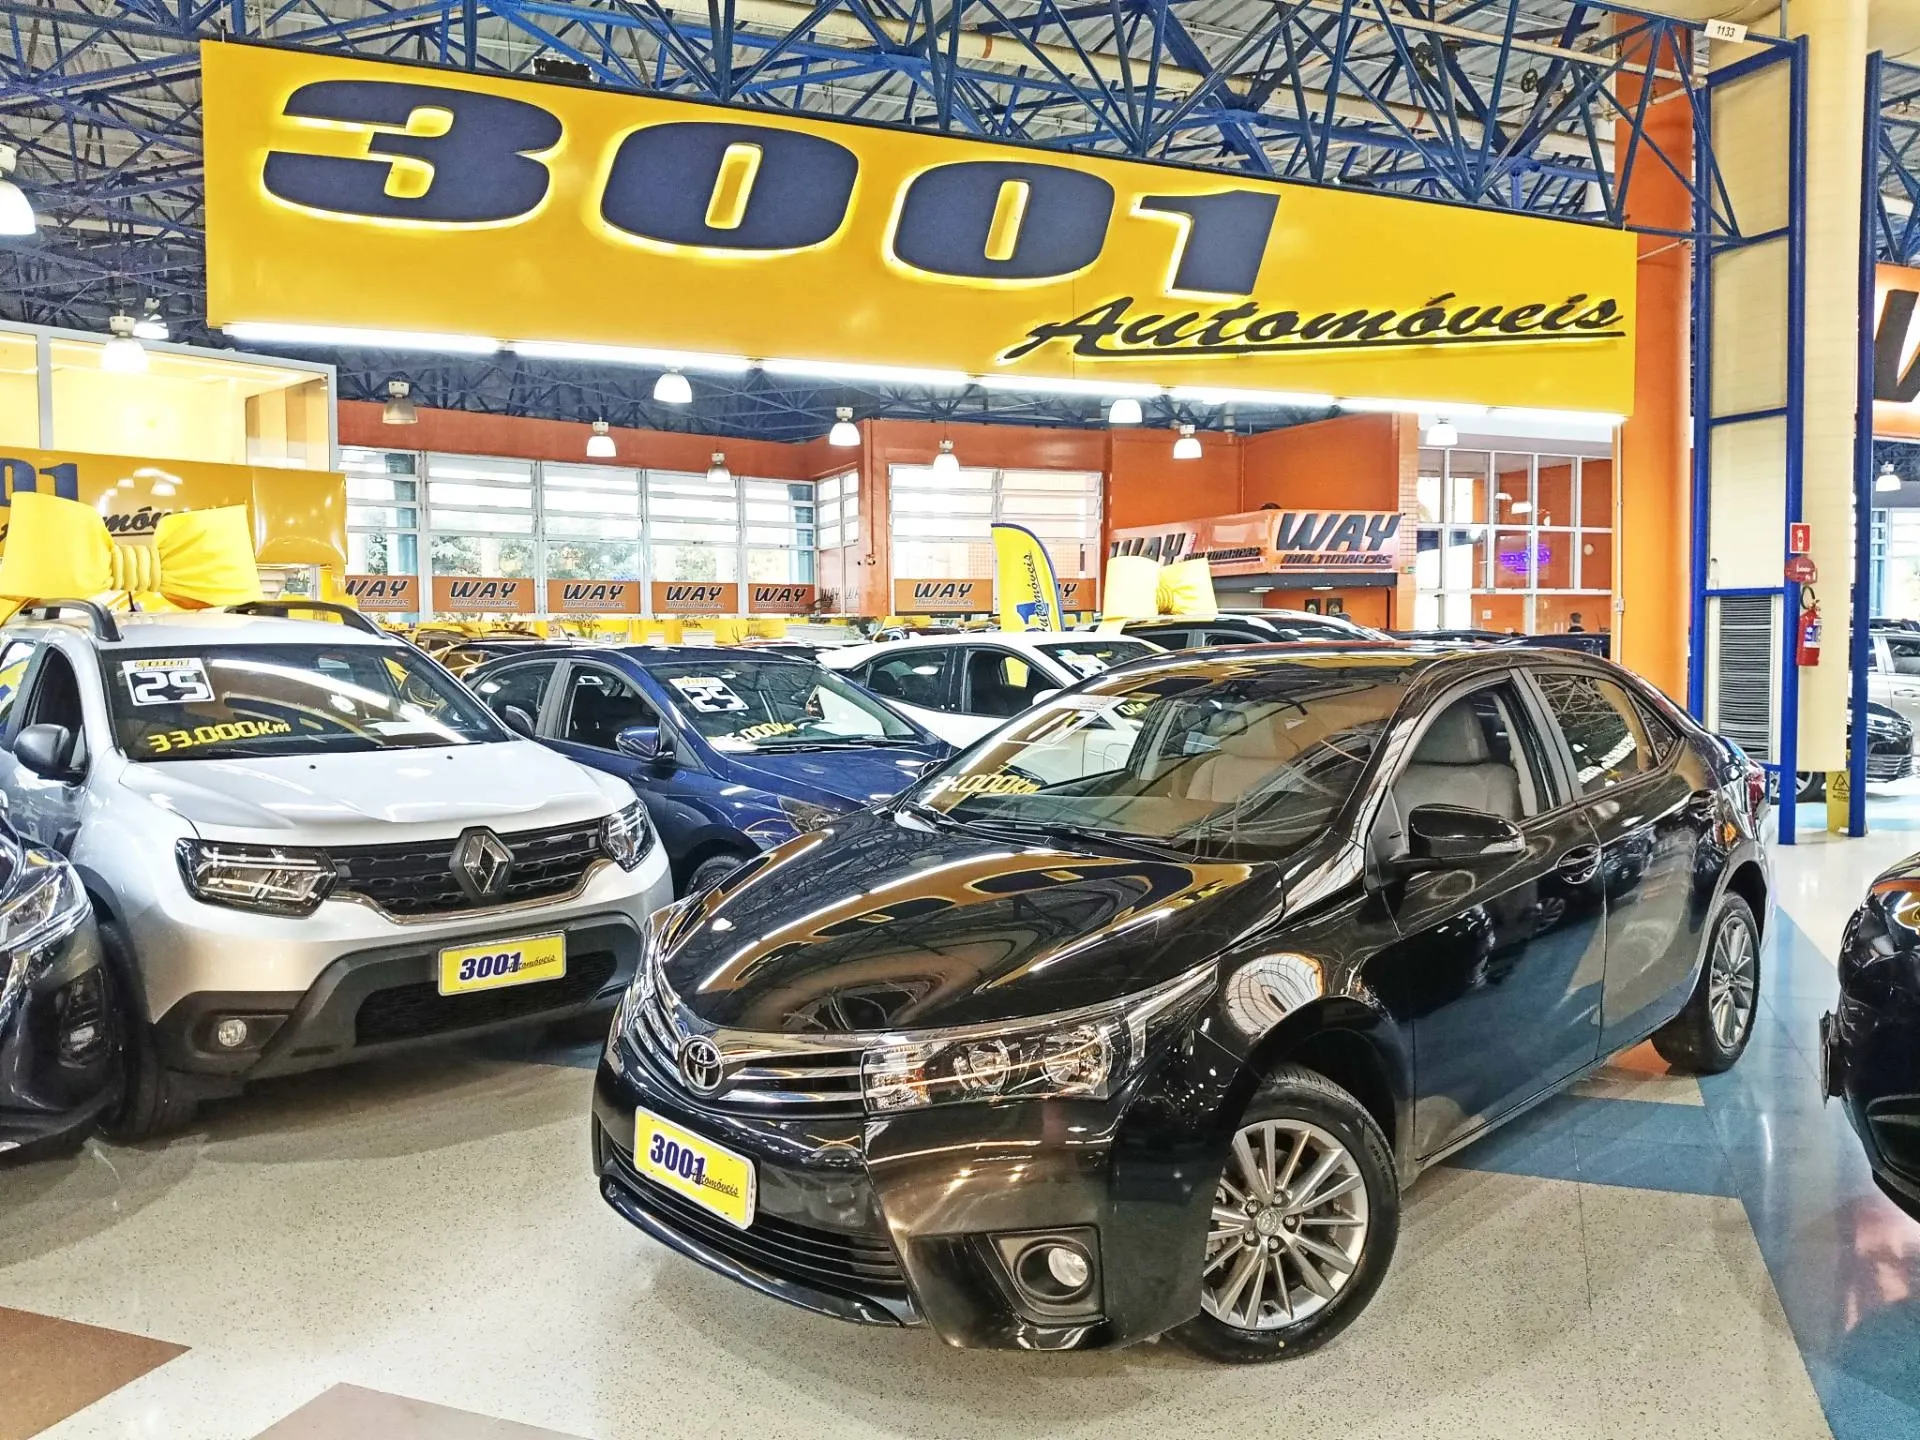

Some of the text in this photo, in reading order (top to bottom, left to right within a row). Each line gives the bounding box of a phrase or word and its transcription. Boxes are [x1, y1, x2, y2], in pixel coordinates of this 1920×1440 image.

[1717, 25, 1736, 37] 1133
[263, 79, 1280, 296] 3001
[1003, 292, 1627, 359] Automóveis
[1276, 513, 1401, 551] WAY
[1281, 553, 1393, 565] MULTIMARCAS
[450, 582, 517, 598] WAY
[563, 584, 624, 600] WAY
[666, 586, 722, 601] WAY
[755, 587, 806, 602] WAY
[914, 583, 973, 598] WAY
[134, 669, 210, 703] 25
[684, 686, 745, 710] 25
[148, 721, 292, 752] 33.000Km
[460, 952, 521, 981] 3001
[650, 1133, 706, 1186] 3001
